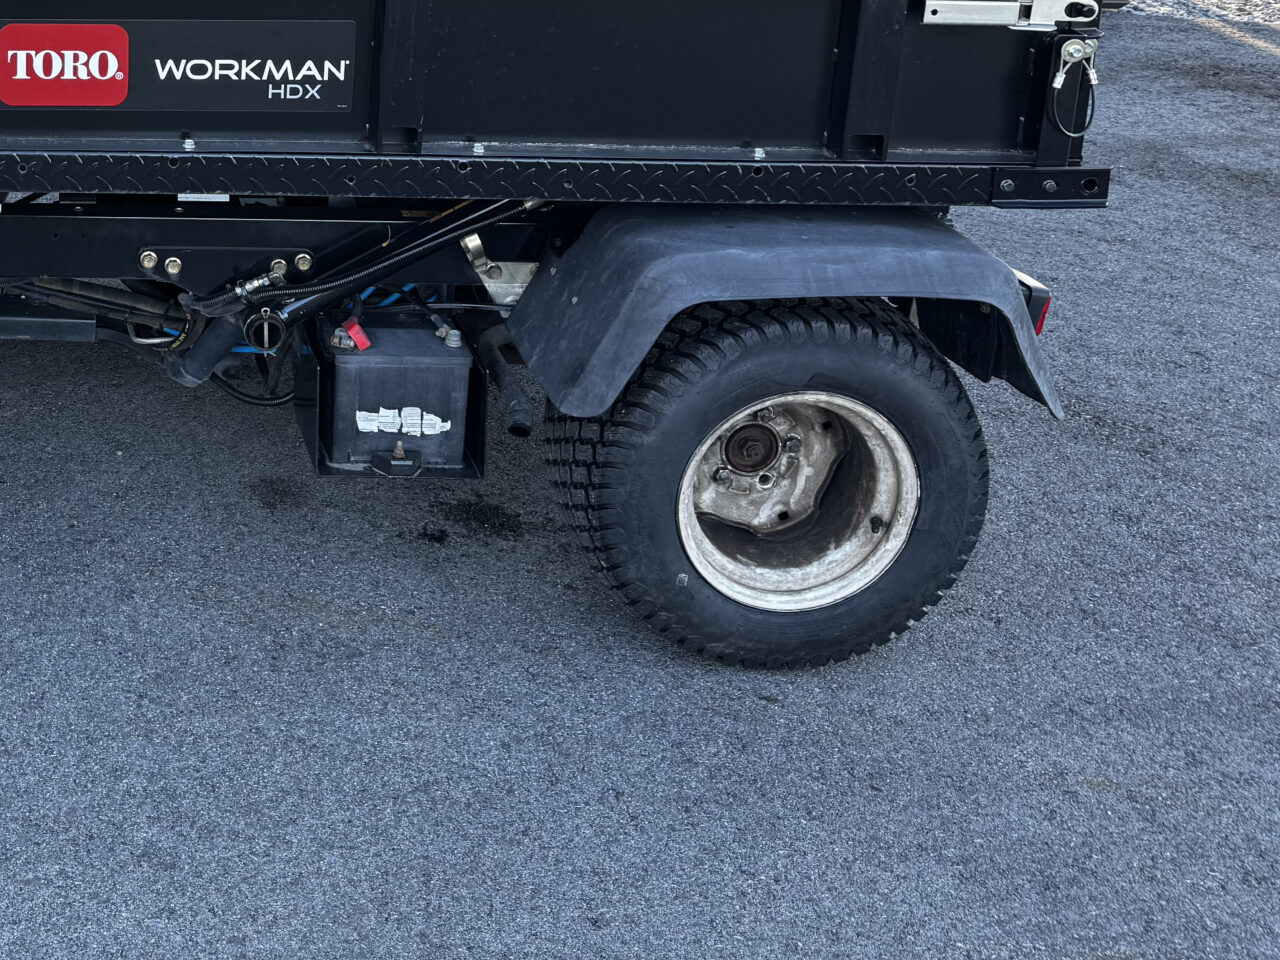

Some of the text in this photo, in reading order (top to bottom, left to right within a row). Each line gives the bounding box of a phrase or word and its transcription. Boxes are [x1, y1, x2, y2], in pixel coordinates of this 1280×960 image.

[7, 49, 119, 80] TORO
[154, 58, 346, 81] WORKMAN
[268, 83, 322, 100] HDX
